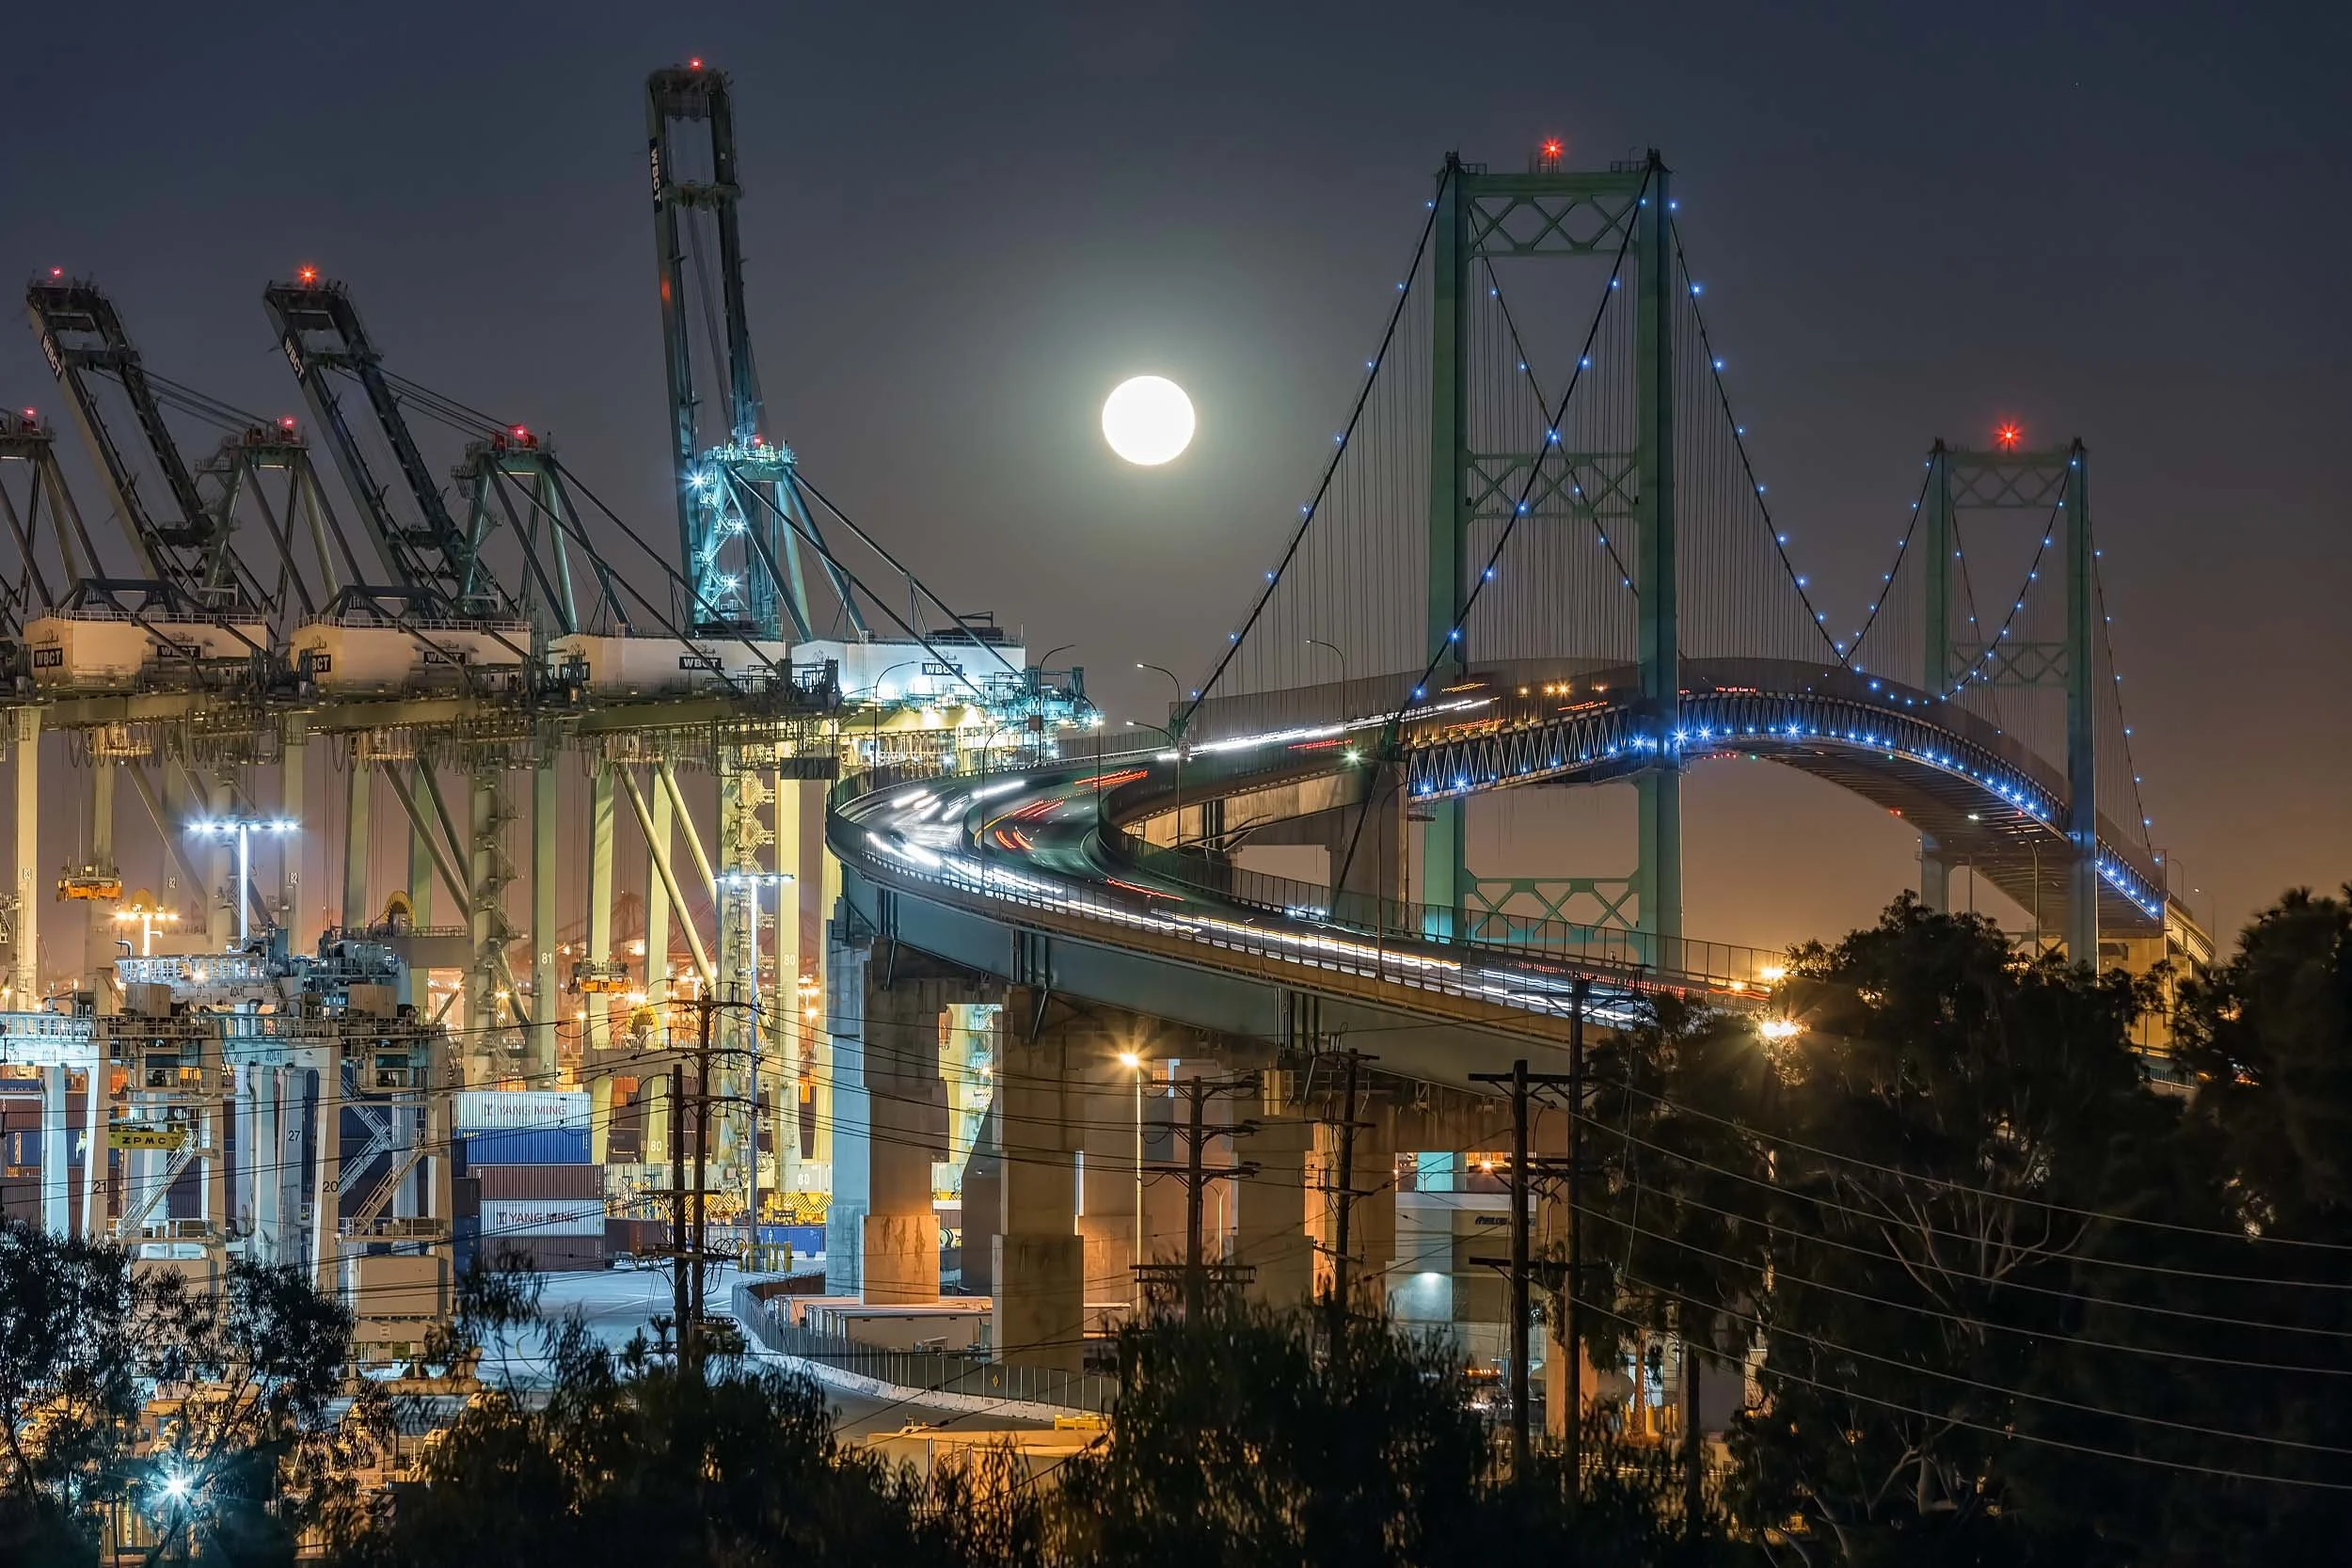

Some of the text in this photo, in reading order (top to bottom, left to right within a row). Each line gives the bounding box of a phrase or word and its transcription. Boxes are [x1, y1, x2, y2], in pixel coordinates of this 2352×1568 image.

[651, 147, 661, 202] WBCT
[43, 334, 62, 376] WBCT
[285, 337, 305, 379] WBCT
[161, 646, 196, 656] WT
[36, 649, 61, 666] WBCT
[290, 872, 298, 884] 82
[541, 952, 552, 964] 81
[784, 954, 796, 966] 80
[498, 1105, 566, 1116] YANG MING
[121, 1136, 167, 1145] ZPMC
[288, 1130, 301, 1142] 27
[650, 1139, 662, 1152] 80
[797, 1173, 810, 1186] 80
[93, 1180, 107, 1194] 21
[323, 1180, 339, 1193] 20
[509, 1212, 580, 1224] YANG MING
